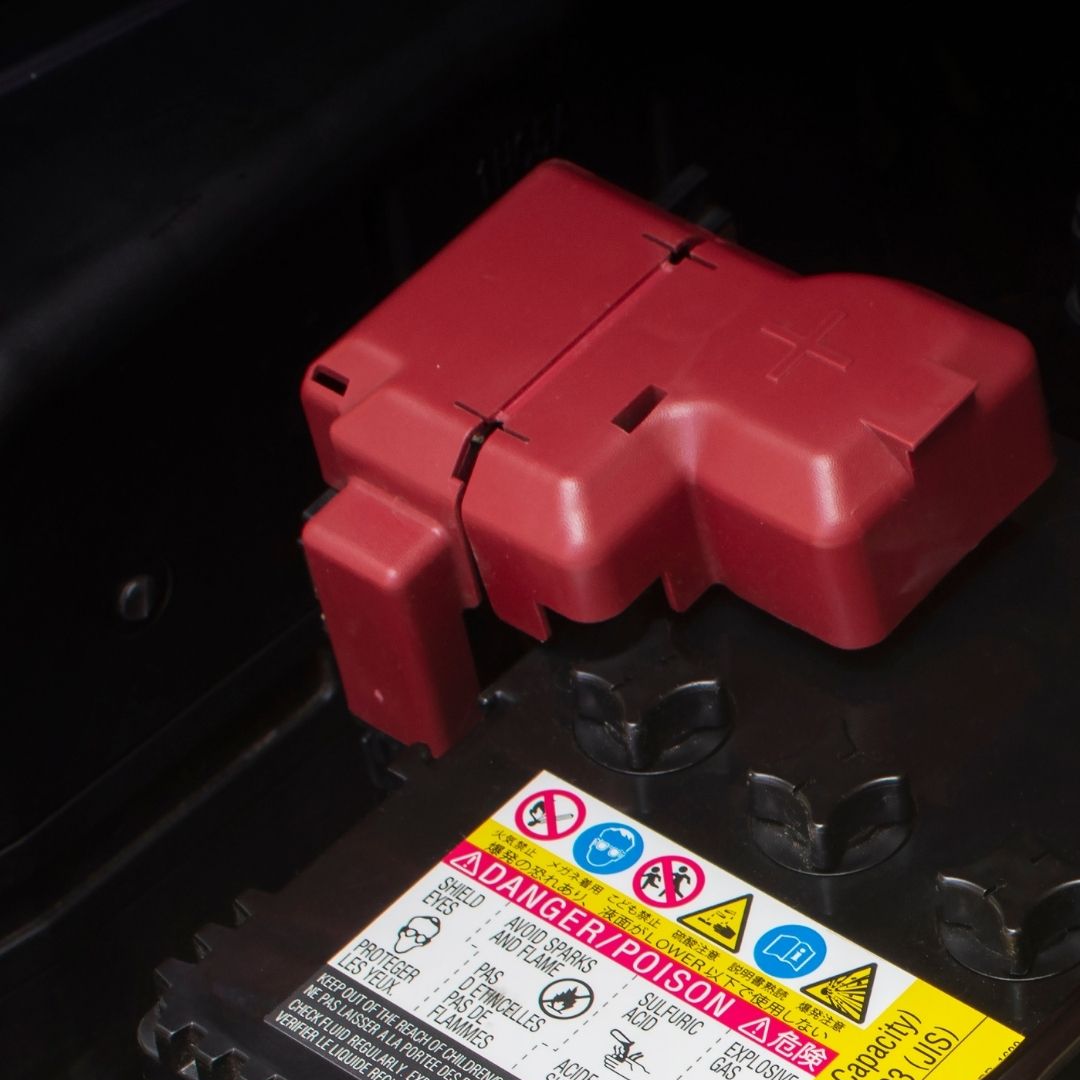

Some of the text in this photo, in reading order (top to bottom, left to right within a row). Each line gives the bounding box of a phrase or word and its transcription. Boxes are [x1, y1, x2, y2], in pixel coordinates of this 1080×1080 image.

[421, 888, 460, 916] EYES
[437, 875, 486, 908] SHIELD
[494, 829, 536, 858] 火気禁止
[551, 861, 605, 895] メガネ着用
[606, 893, 661, 929] こども禁止
[352, 937, 421, 984] PROTEGER
[478, 862, 827, 1072] DANGER/POISON 危険
[488, 928, 565, 978] AND FLAME
[503, 915, 598, 974] AVOID SPARKS
[336, 951, 401, 997] LES YEUX.
[472, 961, 505, 985] PAS
[302, 983, 323, 1000] NE
[316, 991, 342, 1012] PAS
[335, 1003, 381, 1035] LAISSER
[375, 1028, 390, 1042] A
[383, 1032, 403, 1050] LA
[398, 1041, 442, 1072] PORTEE
[315, 971, 347, 992] KEEP
[340, 986, 368, 1006] OUT
[360, 998, 382, 1013] OF
[375, 1006, 400, 1027] THE
[393, 1018, 433, 1046] REACH
[426, 1038, 448, 1053] OF
[426, 1003, 494, 1050] FLAMMES
[441, 989, 494, 1025] PAS DE
[620, 1006, 658, 1032] ACID
[637, 991, 705, 1036] SULFURIC
[274, 1009, 320, 1042] VERIFIER
[314, 1034, 334, 1051] LE
[327, 1042, 373, 1075] LIQUIDE
[287, 998, 324, 1024] CHECK
[316, 1015, 351, 1041] FLUID
[346, 1033, 408, 1077] REGULARLY.
[902, 1025, 959, 1071] (JIS)
[708, 1055, 742, 1080] GAS
